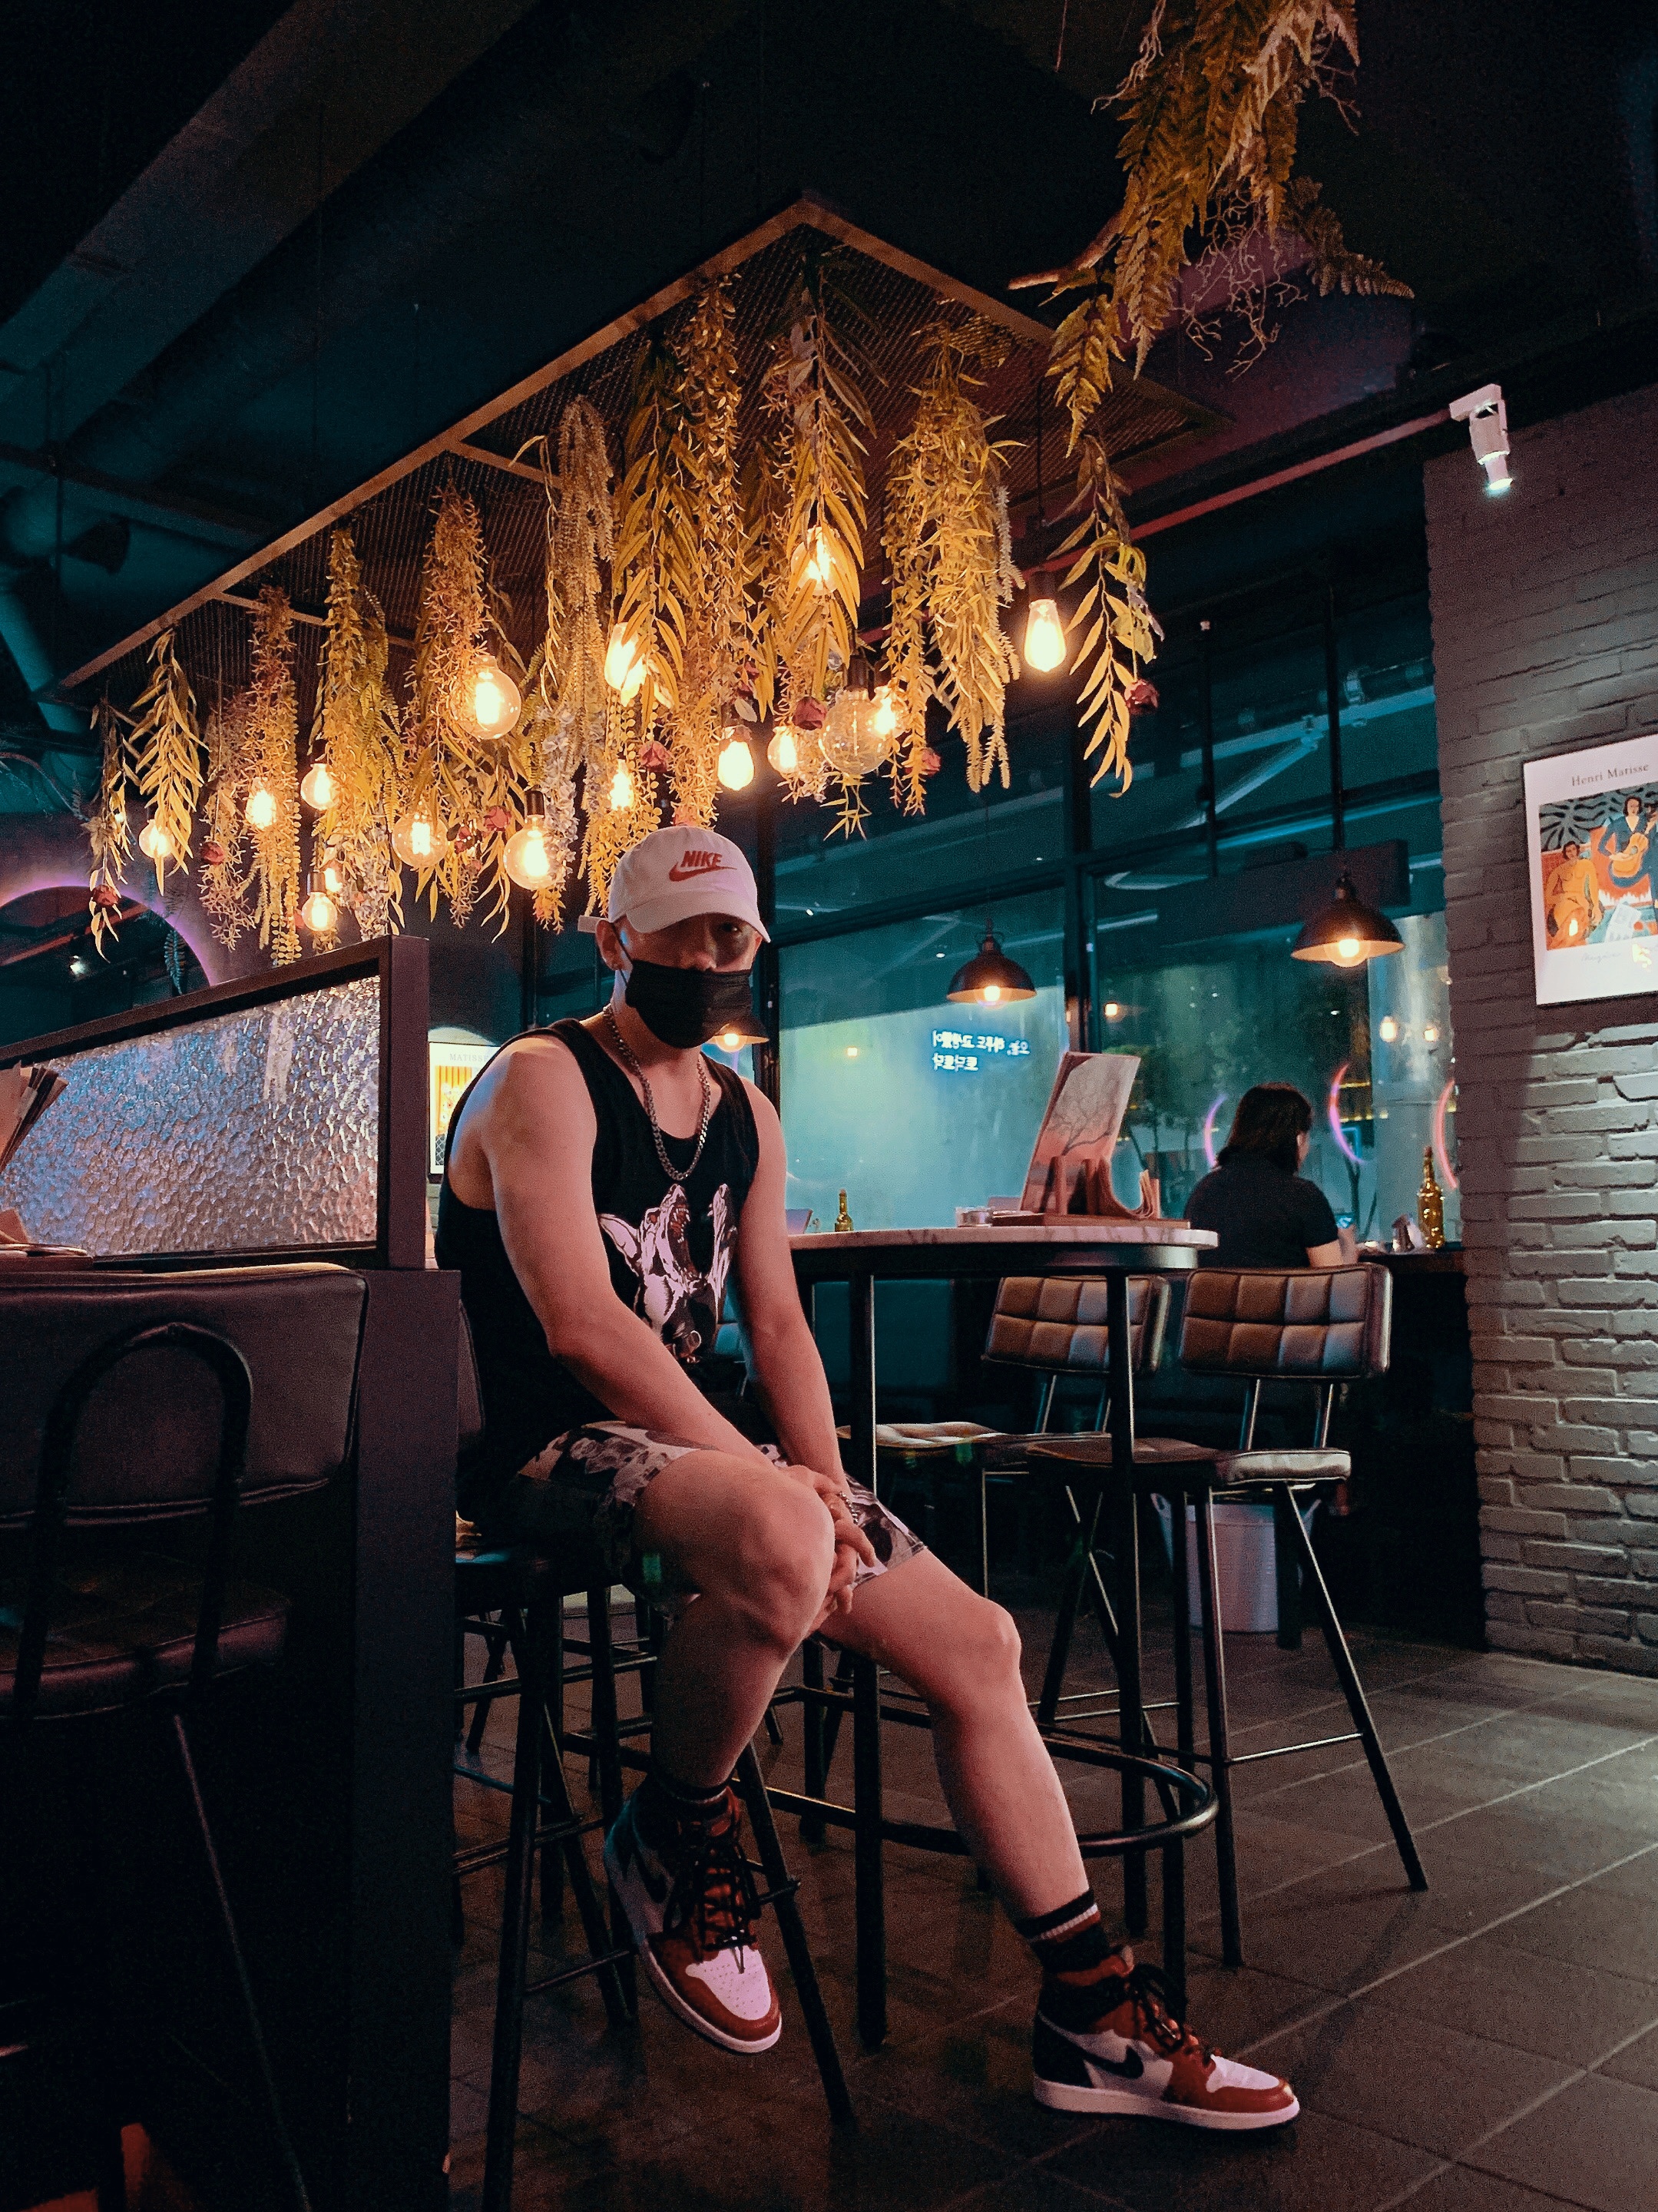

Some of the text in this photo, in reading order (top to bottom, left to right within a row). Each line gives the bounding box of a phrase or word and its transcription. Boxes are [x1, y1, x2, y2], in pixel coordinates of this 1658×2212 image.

[1571, 764, 1649, 786] Henri Matisse
[680, 850, 723, 868] NIKE
